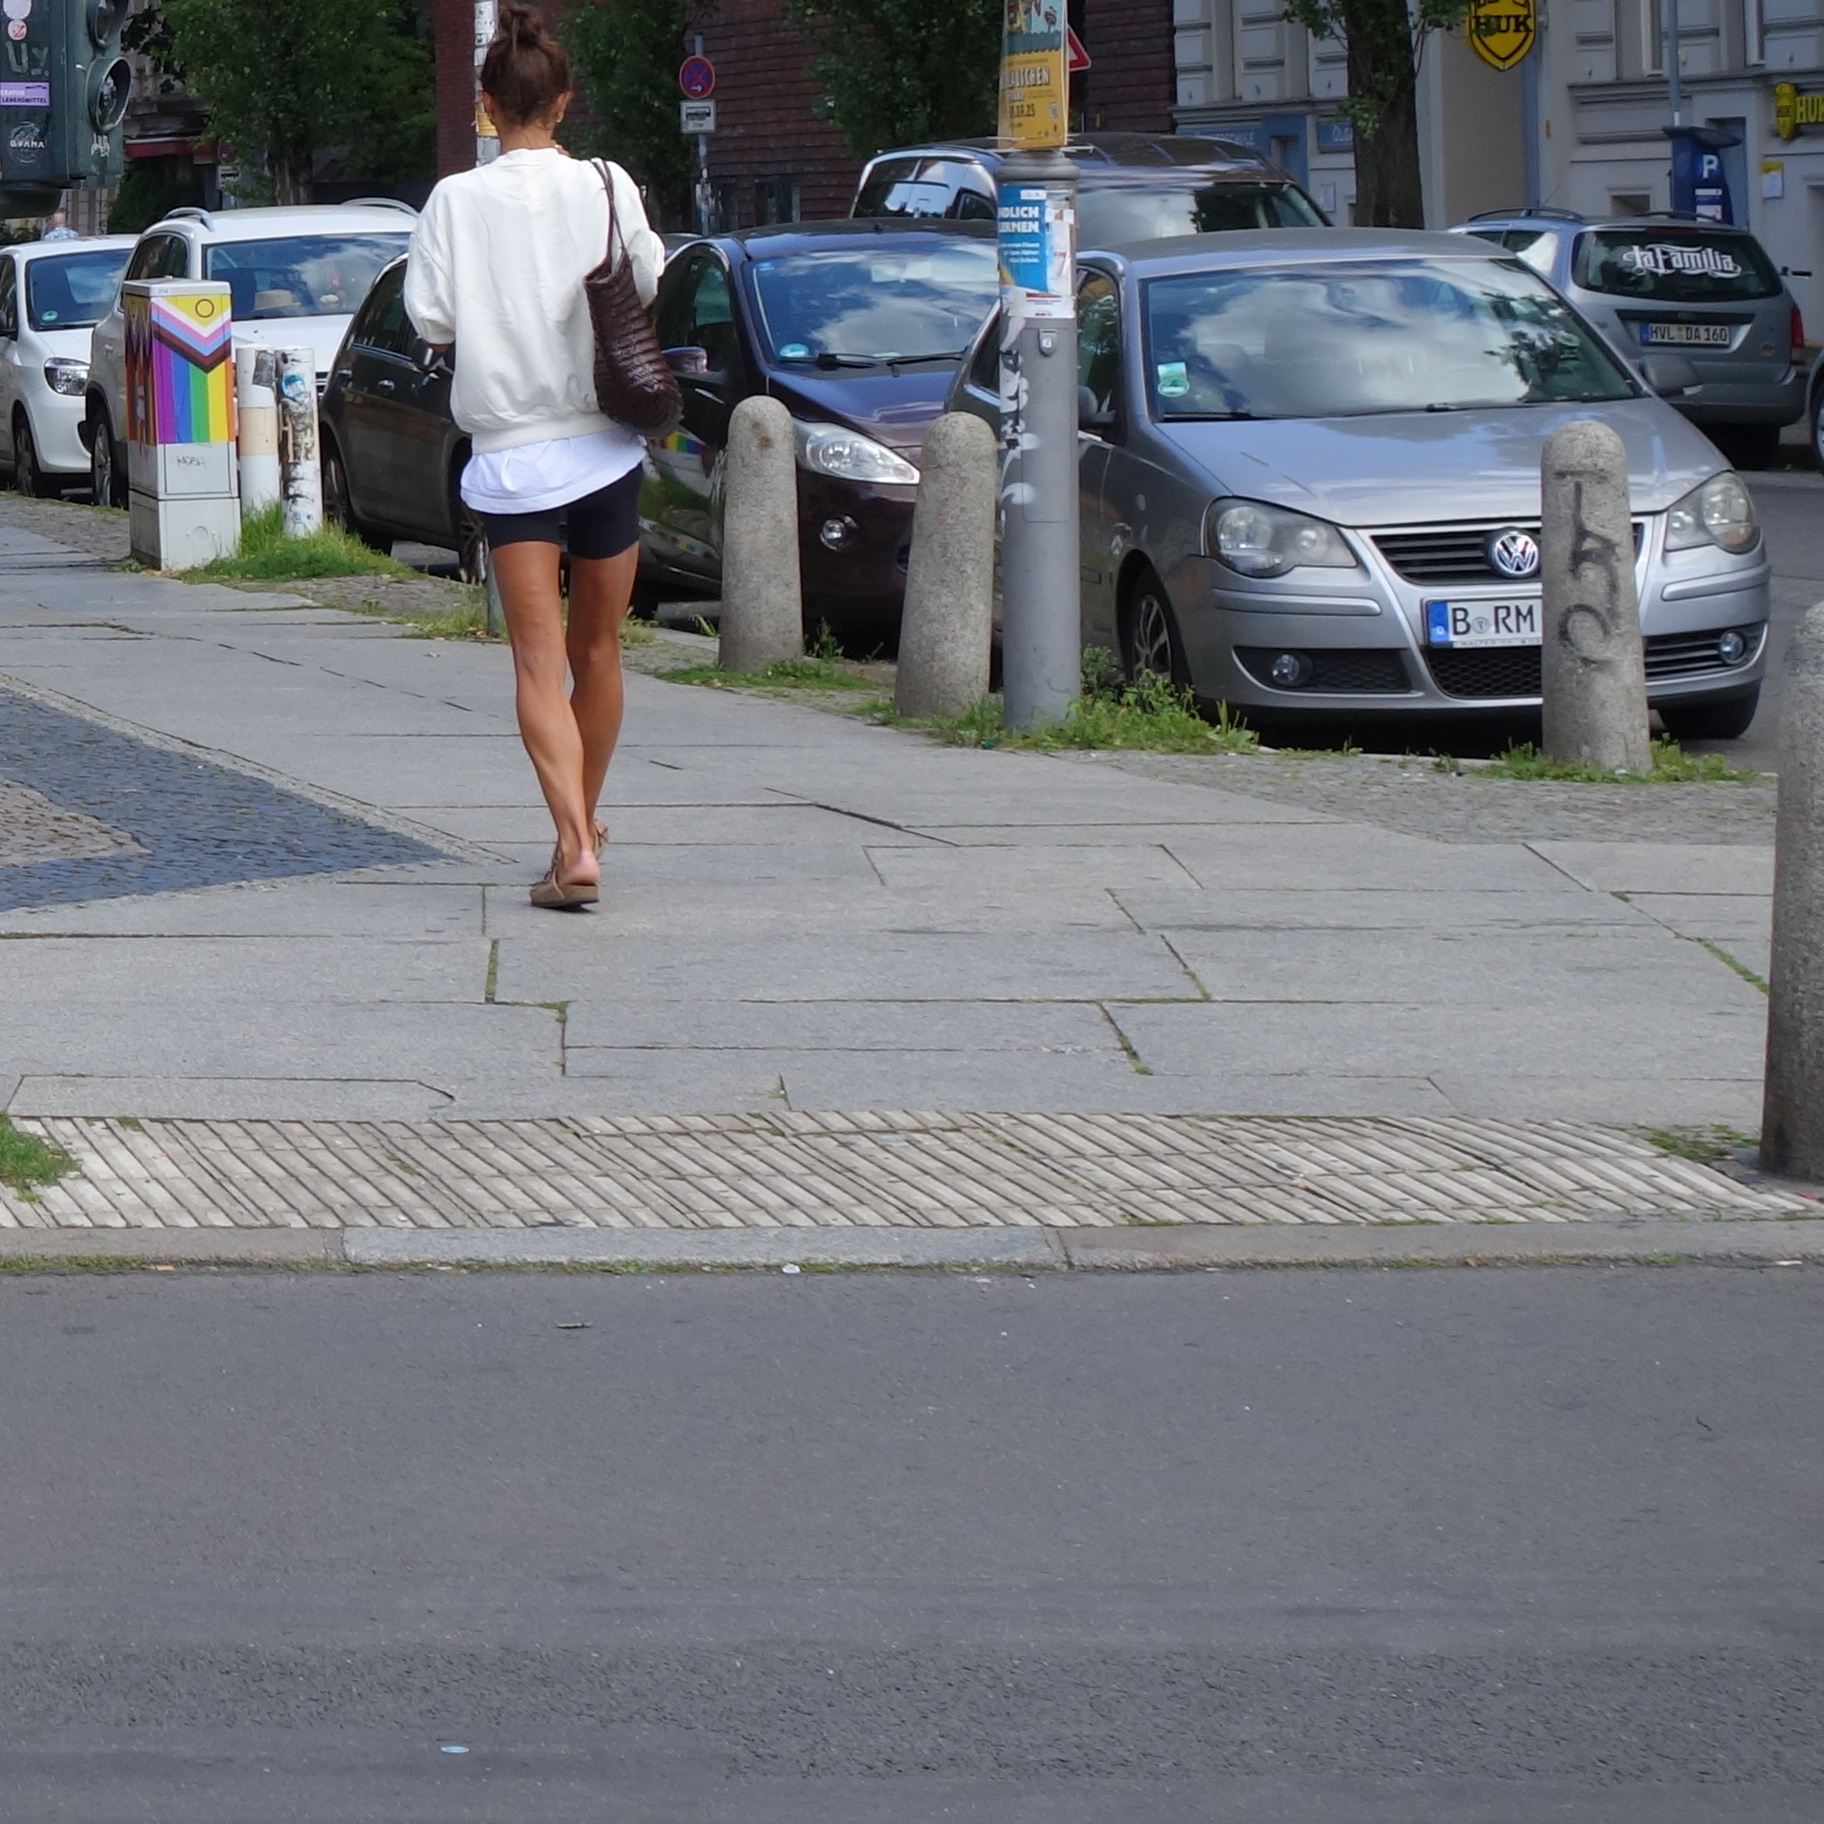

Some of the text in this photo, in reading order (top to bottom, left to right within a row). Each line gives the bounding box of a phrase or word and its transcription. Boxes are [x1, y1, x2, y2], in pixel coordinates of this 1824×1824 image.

[1472, 14, 1532, 33] HUK
[1703, 154, 1718, 179] P
[1652, 326, 1728, 342] HVL DA 160
[1452, 604, 1535, 636] B RM
